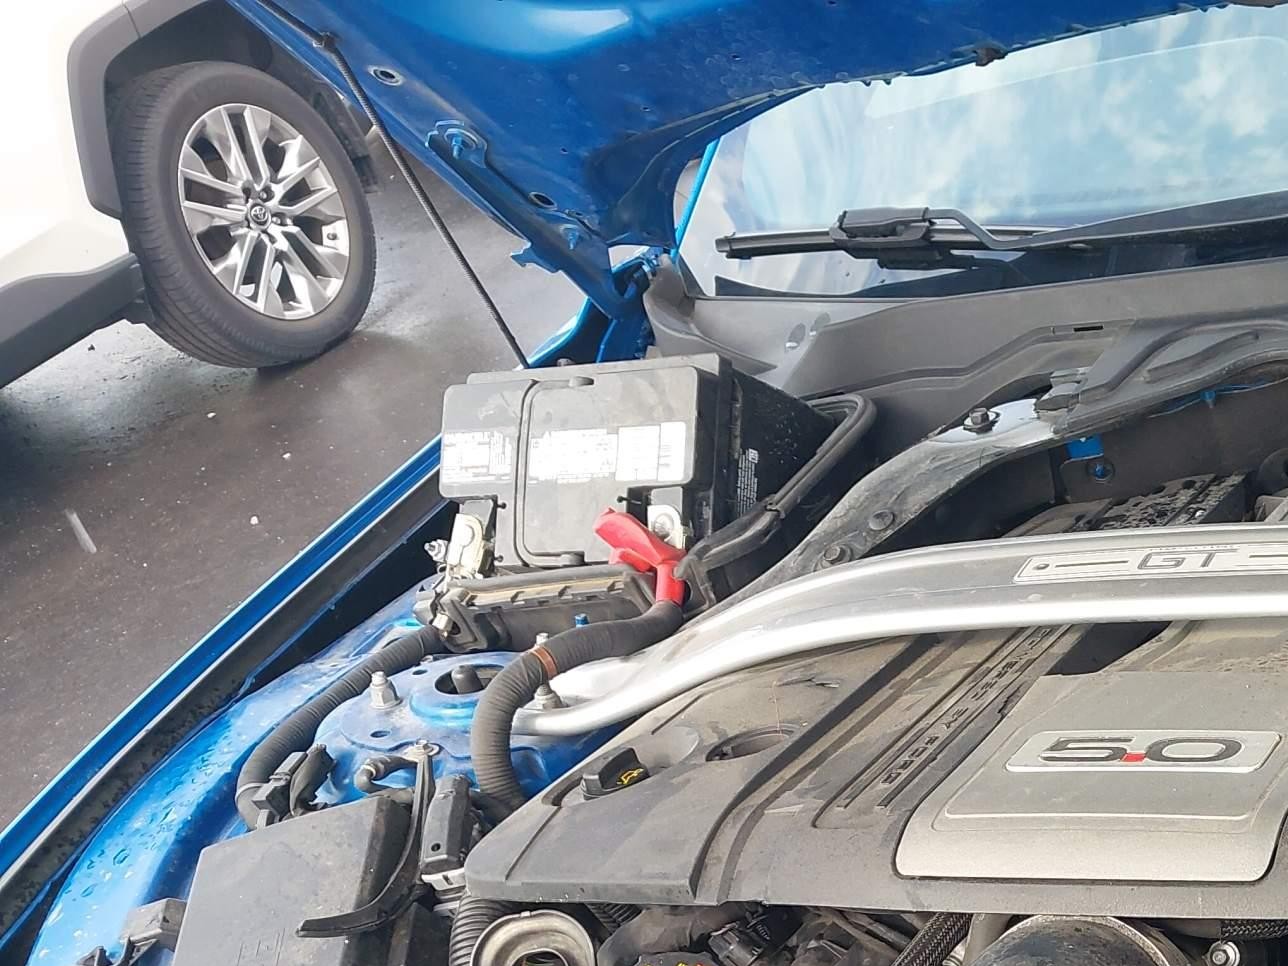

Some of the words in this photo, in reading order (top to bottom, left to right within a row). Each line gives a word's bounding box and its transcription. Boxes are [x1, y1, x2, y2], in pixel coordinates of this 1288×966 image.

[1137, 548, 1239, 570] GT
[880, 735, 940, 785] FORD
[1038, 736, 1244, 763] 5.0
